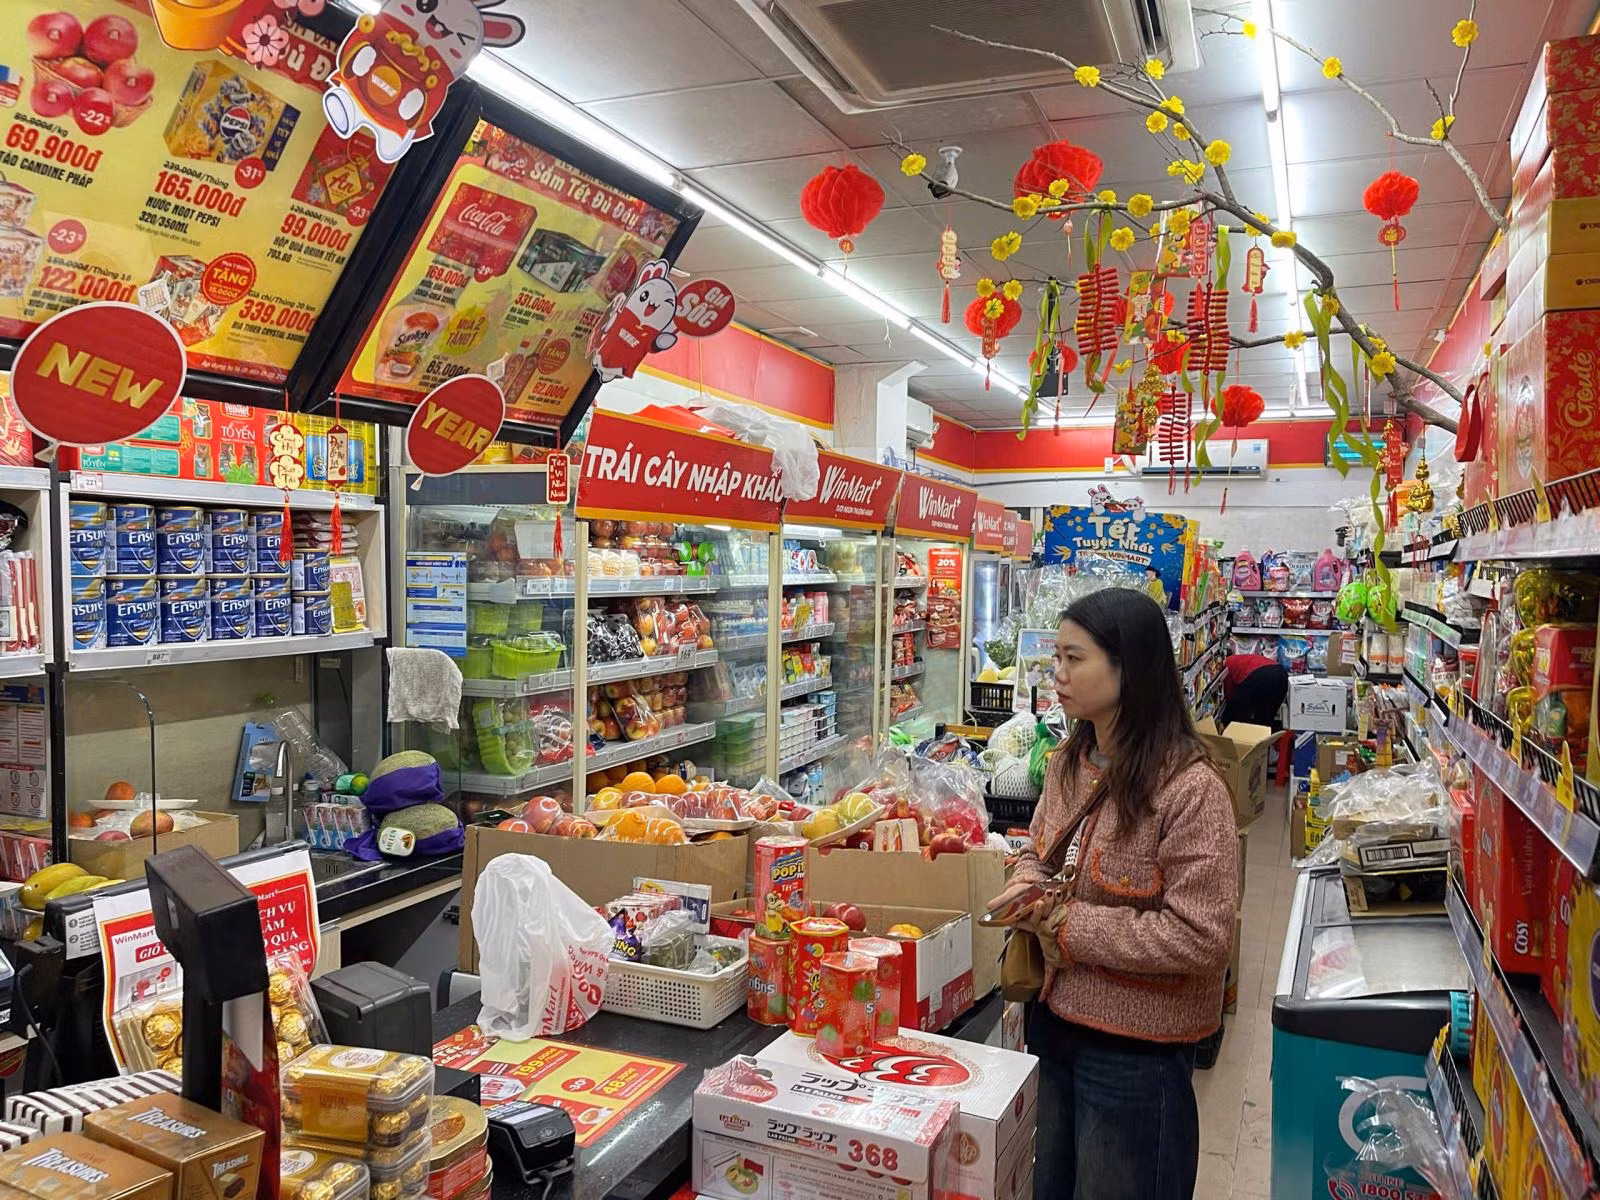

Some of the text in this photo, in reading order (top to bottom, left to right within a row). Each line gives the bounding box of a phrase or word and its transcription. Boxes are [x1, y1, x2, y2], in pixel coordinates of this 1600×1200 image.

[223, 115, 248, 130] PEPSI
[6, 123, 104, 173] 69.900đ
[19, 157, 66, 181] CANDINE
[65, 171, 94, 188] PHÁP
[154, 170, 248, 218] 165.000đ
[529, 161, 566, 194] Sắm
[567, 177, 591, 203] Tết
[591, 190, 614, 214] Đủ
[138, 210, 189, 234] 320/350ML
[145, 195, 221, 228] NƯỚC NGỌT PEPSI
[280, 212, 353, 252] 99.000đ
[38, 265, 137, 302] 122.000đ
[212, 266, 249, 286] TẶNG
[514, 291, 556, 315] 331.000đ
[677, 292, 719, 329] SỐC
[394, 329, 430, 347] Sunlight
[36, 342, 164, 410] NEW
[221, 421, 256, 441] TỔ YẾN
[421, 401, 493, 453] YEAR
[586, 442, 642, 484] TRÁI
[644, 450, 689, 489] CÂY
[687, 461, 743, 502] NHẬP
[1088, 516, 1141, 543] Tết
[1072, 536, 1114, 551] Tuyệt
[1119, 537, 1155, 555] Nhất
[937, 558, 957, 567] 20%
[279, 901, 296, 916] VỤ
[260, 918, 285, 934] ÀM
[271, 928, 299, 946] QUÀ
[1514, 919, 1530, 955] COSY
[139, 943, 161, 960] GIỎ
[513, 1059, 546, 1078] 199
[602, 1080, 626, 1095] 48
[848, 1139, 898, 1171] 368
